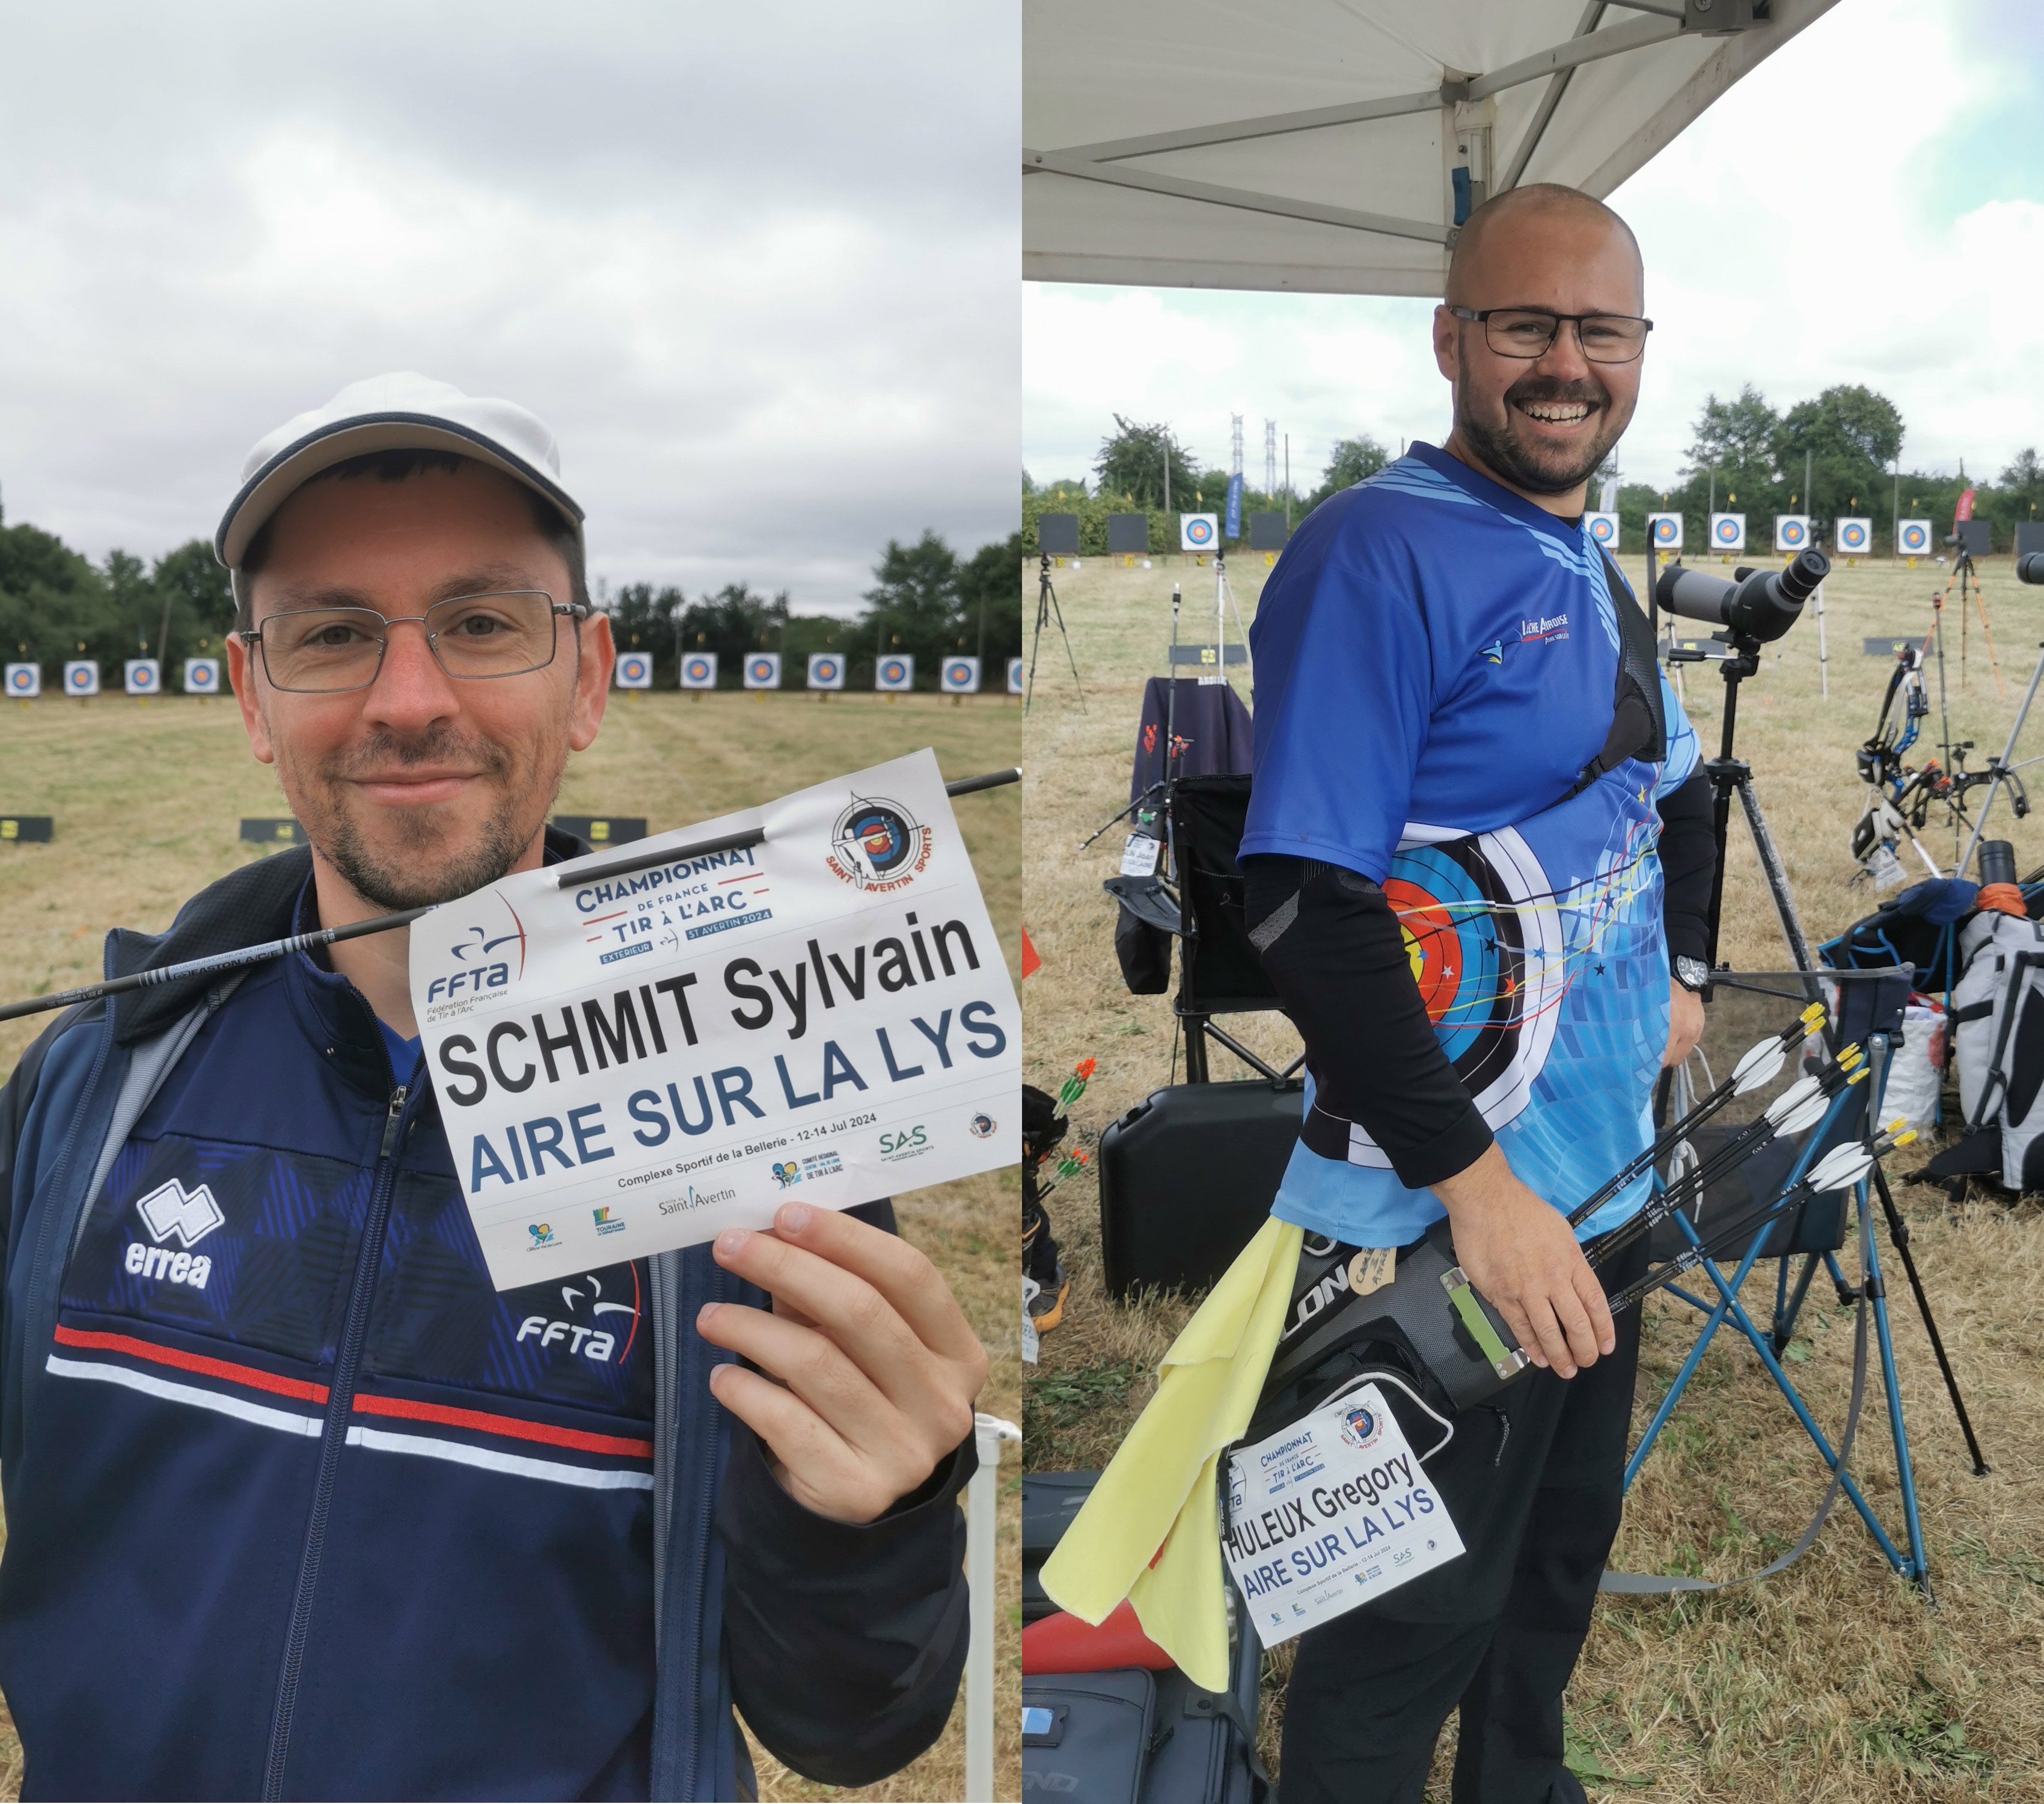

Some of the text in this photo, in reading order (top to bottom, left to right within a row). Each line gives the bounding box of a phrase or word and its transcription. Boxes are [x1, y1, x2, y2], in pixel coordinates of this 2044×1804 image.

[1540, 614, 1568, 634] AIROISE
[826, 827, 932, 892] SAINT AVERTIN SPORTS
[575, 844, 756, 912] CHAMPIONNAT
[638, 883, 709, 911] DE FRANCE
[602, 910, 770, 963] EXTERIEUR ST AVERTIN 2024
[612, 916, 653, 942] TIR
[661, 910, 672, 925] À
[191, 949, 281, 976] EASTON A/C/E
[427, 990, 508, 1015] Fédération Française
[439, 912, 981, 1106] SCHMIT Sylvain
[457, 1005, 474, 1014] l'Arc
[471, 1001, 1006, 1194] AIRE SUR LA LYS
[618, 1166, 673, 1188] Complexe
[676, 1155, 714, 1177] Sportif
[716, 1152, 730, 1162] de
[732, 1149, 742, 1158] la
[745, 1137, 787, 1155] Bellerie
[797, 1126, 828, 1141] 12-14
[830, 1117, 848, 1133] Jul
[849, 1112, 877, 1128] 2024
[879, 1125, 926, 1153] SAS
[802, 1150, 839, 1164] COMITÉ RÉGIONAL
[881, 1150, 915, 1162] SAINT-AVERTIN
[814, 1169, 824, 1177] TIR
[824, 1167, 828, 1175] À
[659, 1189, 736, 1215] Saint Avertin
[596, 1222, 625, 1232] TOURAINE
[1280, 1264, 1350, 1342] LON
[1261, 1431, 1312, 1467] CHAMPIONNAT
[1341, 1434, 1353, 1447] SAINT
[1359, 1437, 1378, 1449] AVERTIN
[1273, 1470, 1285, 1483] TIR
[1291, 1456, 1314, 1471] L'ARC
[1285, 1453, 1299, 1464] FRANCE
[1228, 1453, 1414, 1563] HULEUX Gregory
[1243, 1488, 1434, 1600] AIRE SUR LA LYS
[1394, 1548, 1412, 1563] SAS
[1297, 1584, 1317, 1595] Complexe
[1317, 1575, 1332, 1586] Sportif
[1342, 1562, 1359, 1573] Bellerie
[1361, 1554, 1373, 1563] 12-14
[1380, 1545, 1391, 1554] 2024
[1315, 1589, 1344, 1605] Saint Avertin
